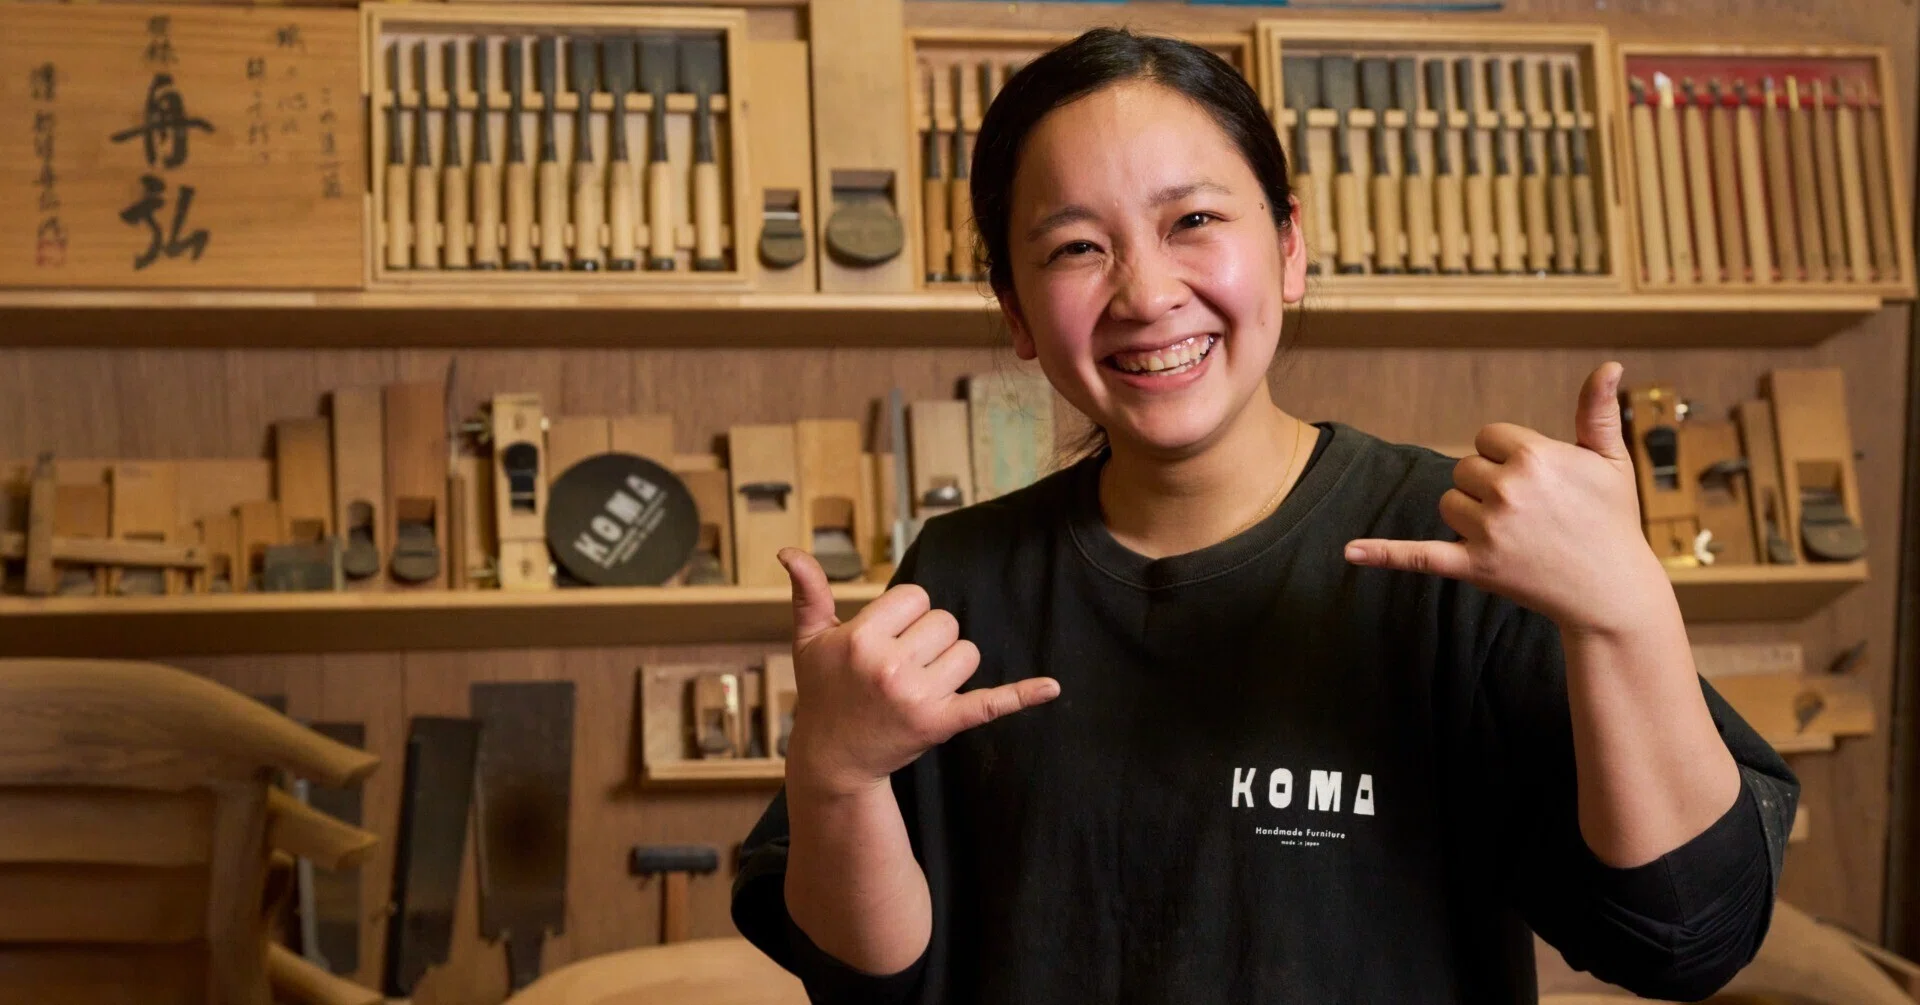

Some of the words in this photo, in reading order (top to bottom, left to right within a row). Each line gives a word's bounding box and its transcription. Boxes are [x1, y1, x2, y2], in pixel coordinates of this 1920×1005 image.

[1231, 767, 1375, 816] KOMA
[1255, 826, 1303, 837] Handmade
[1306, 828, 1346, 839] Furniture
